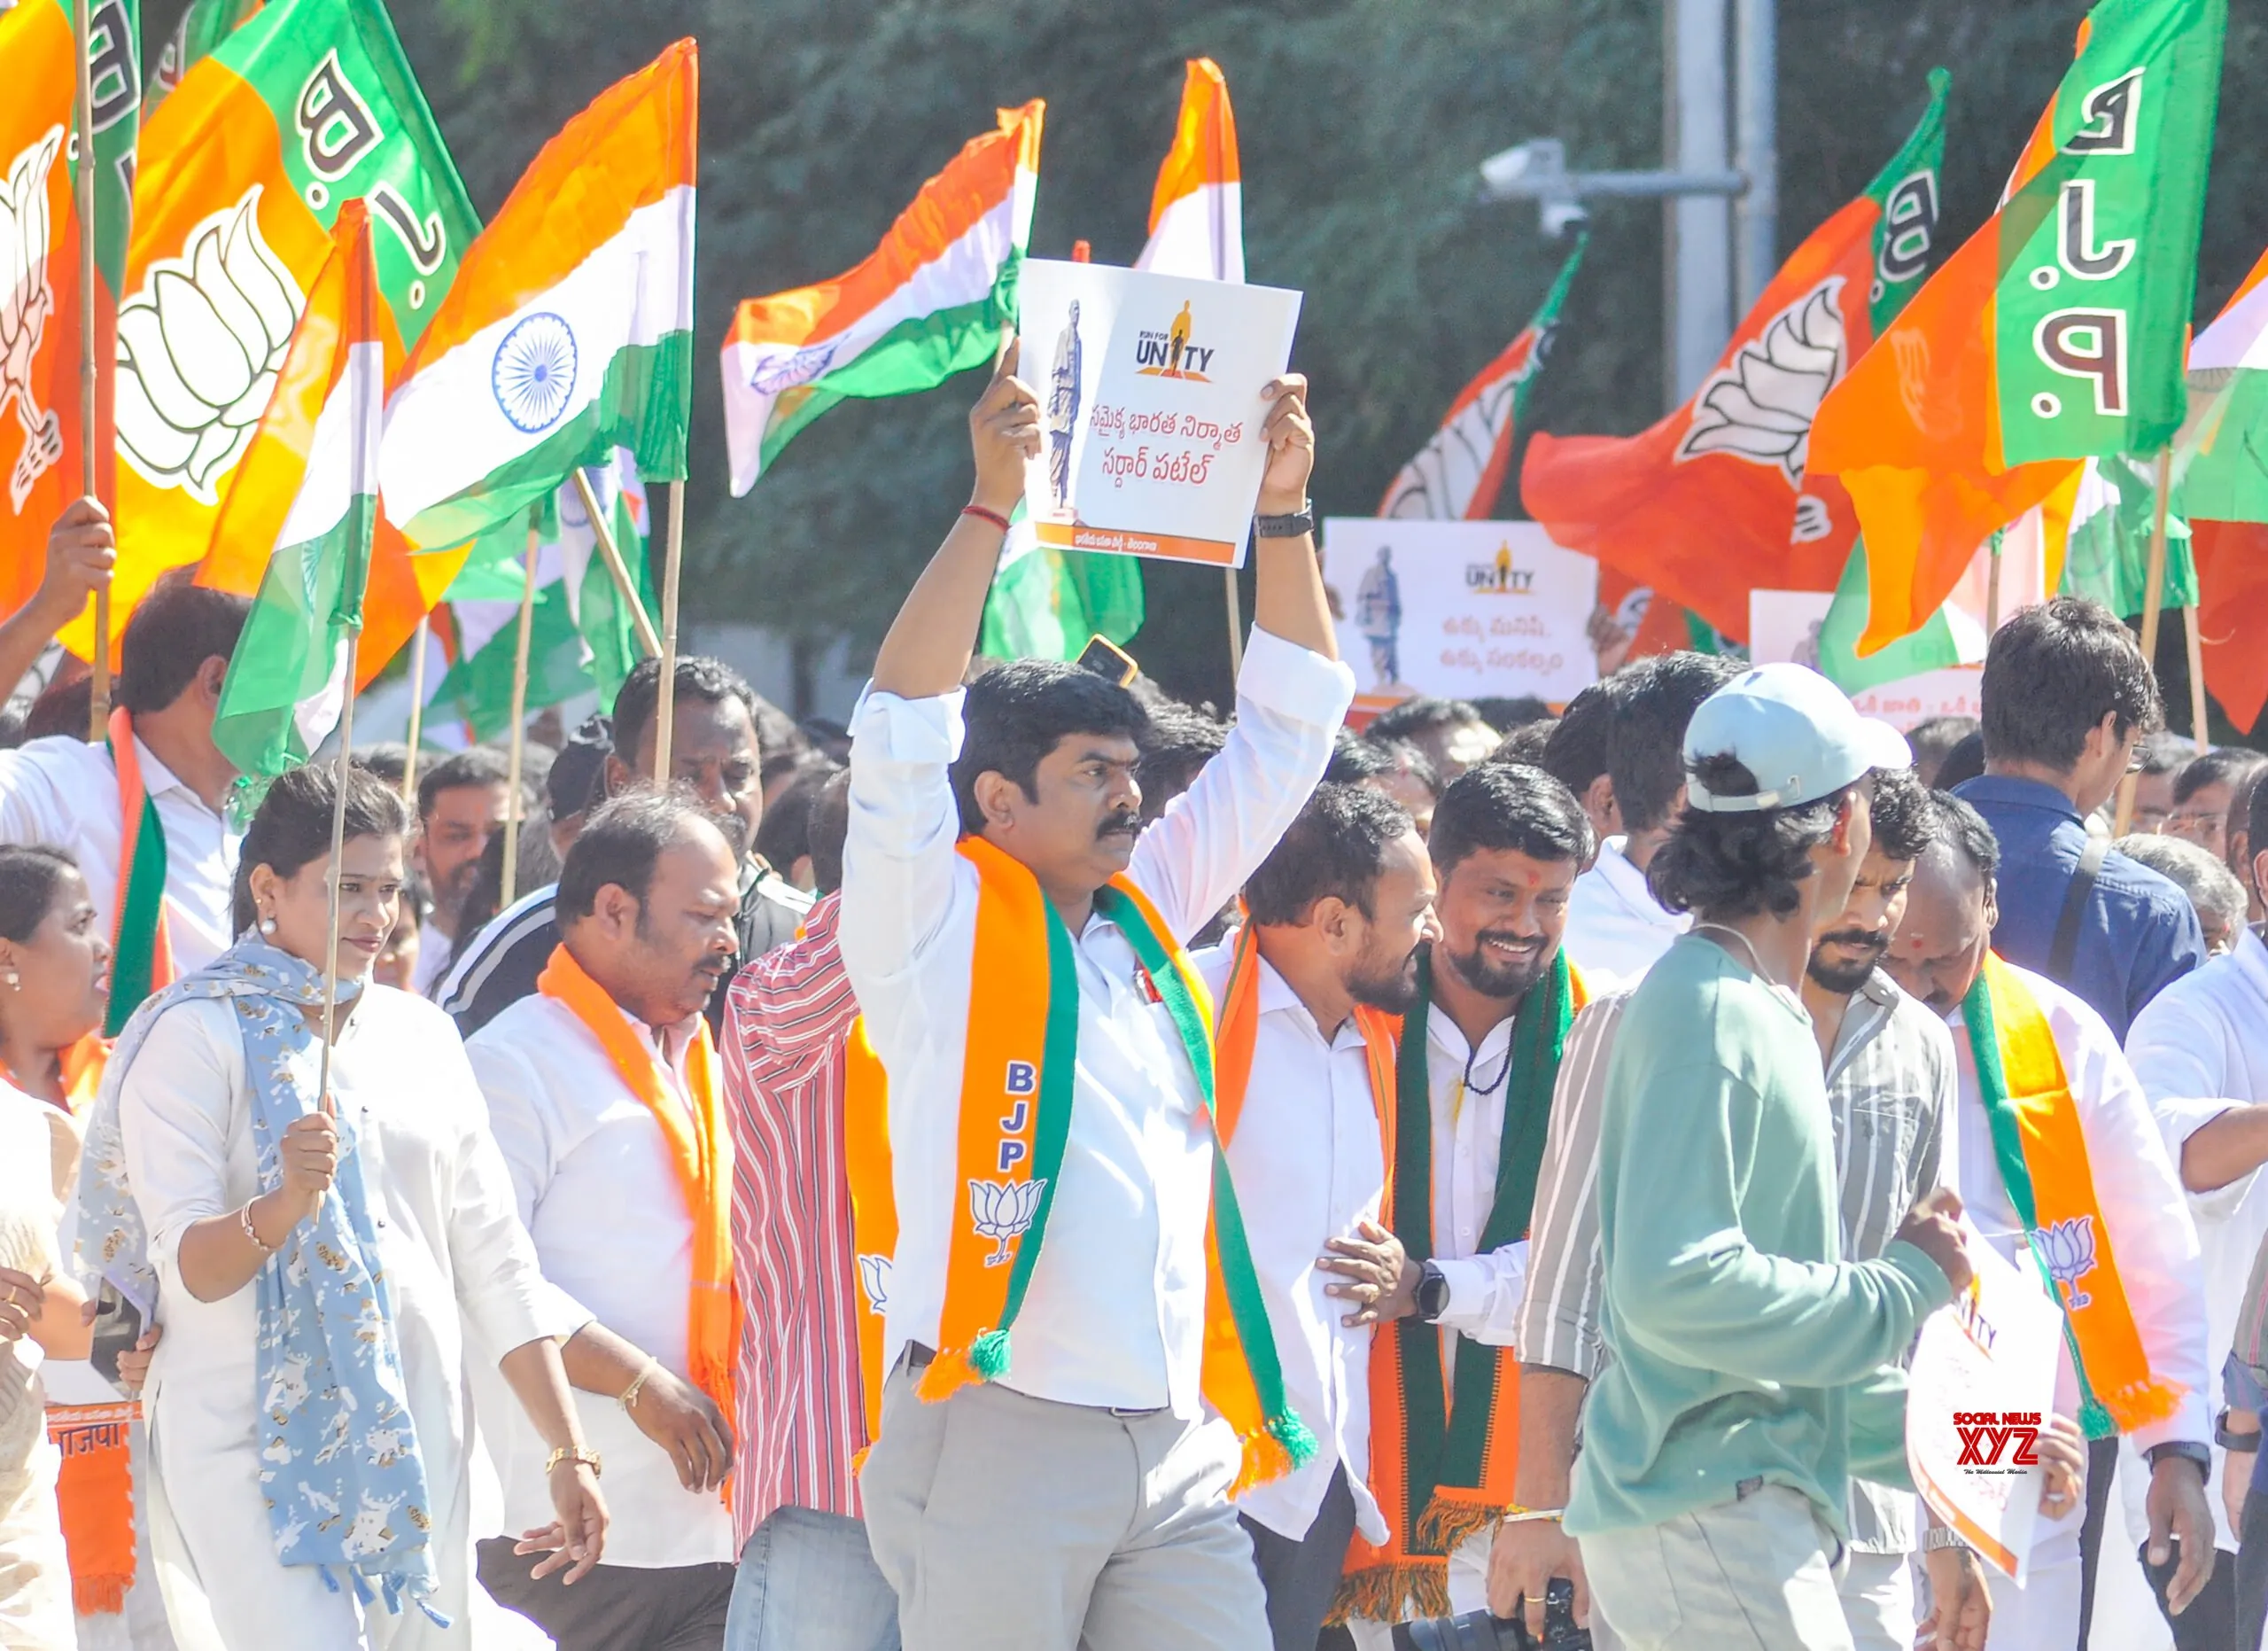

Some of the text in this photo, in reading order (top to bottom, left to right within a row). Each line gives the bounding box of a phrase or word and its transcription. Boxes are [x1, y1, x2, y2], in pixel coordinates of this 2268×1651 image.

[1137, 337, 1214, 372] UNITY
[1090, 404, 1243, 450] సమైక్య భారత నిర్మాత
[1102, 446, 1215, 487] సర్దార్ పటేల్
[1465, 568, 1535, 588] UNITY
